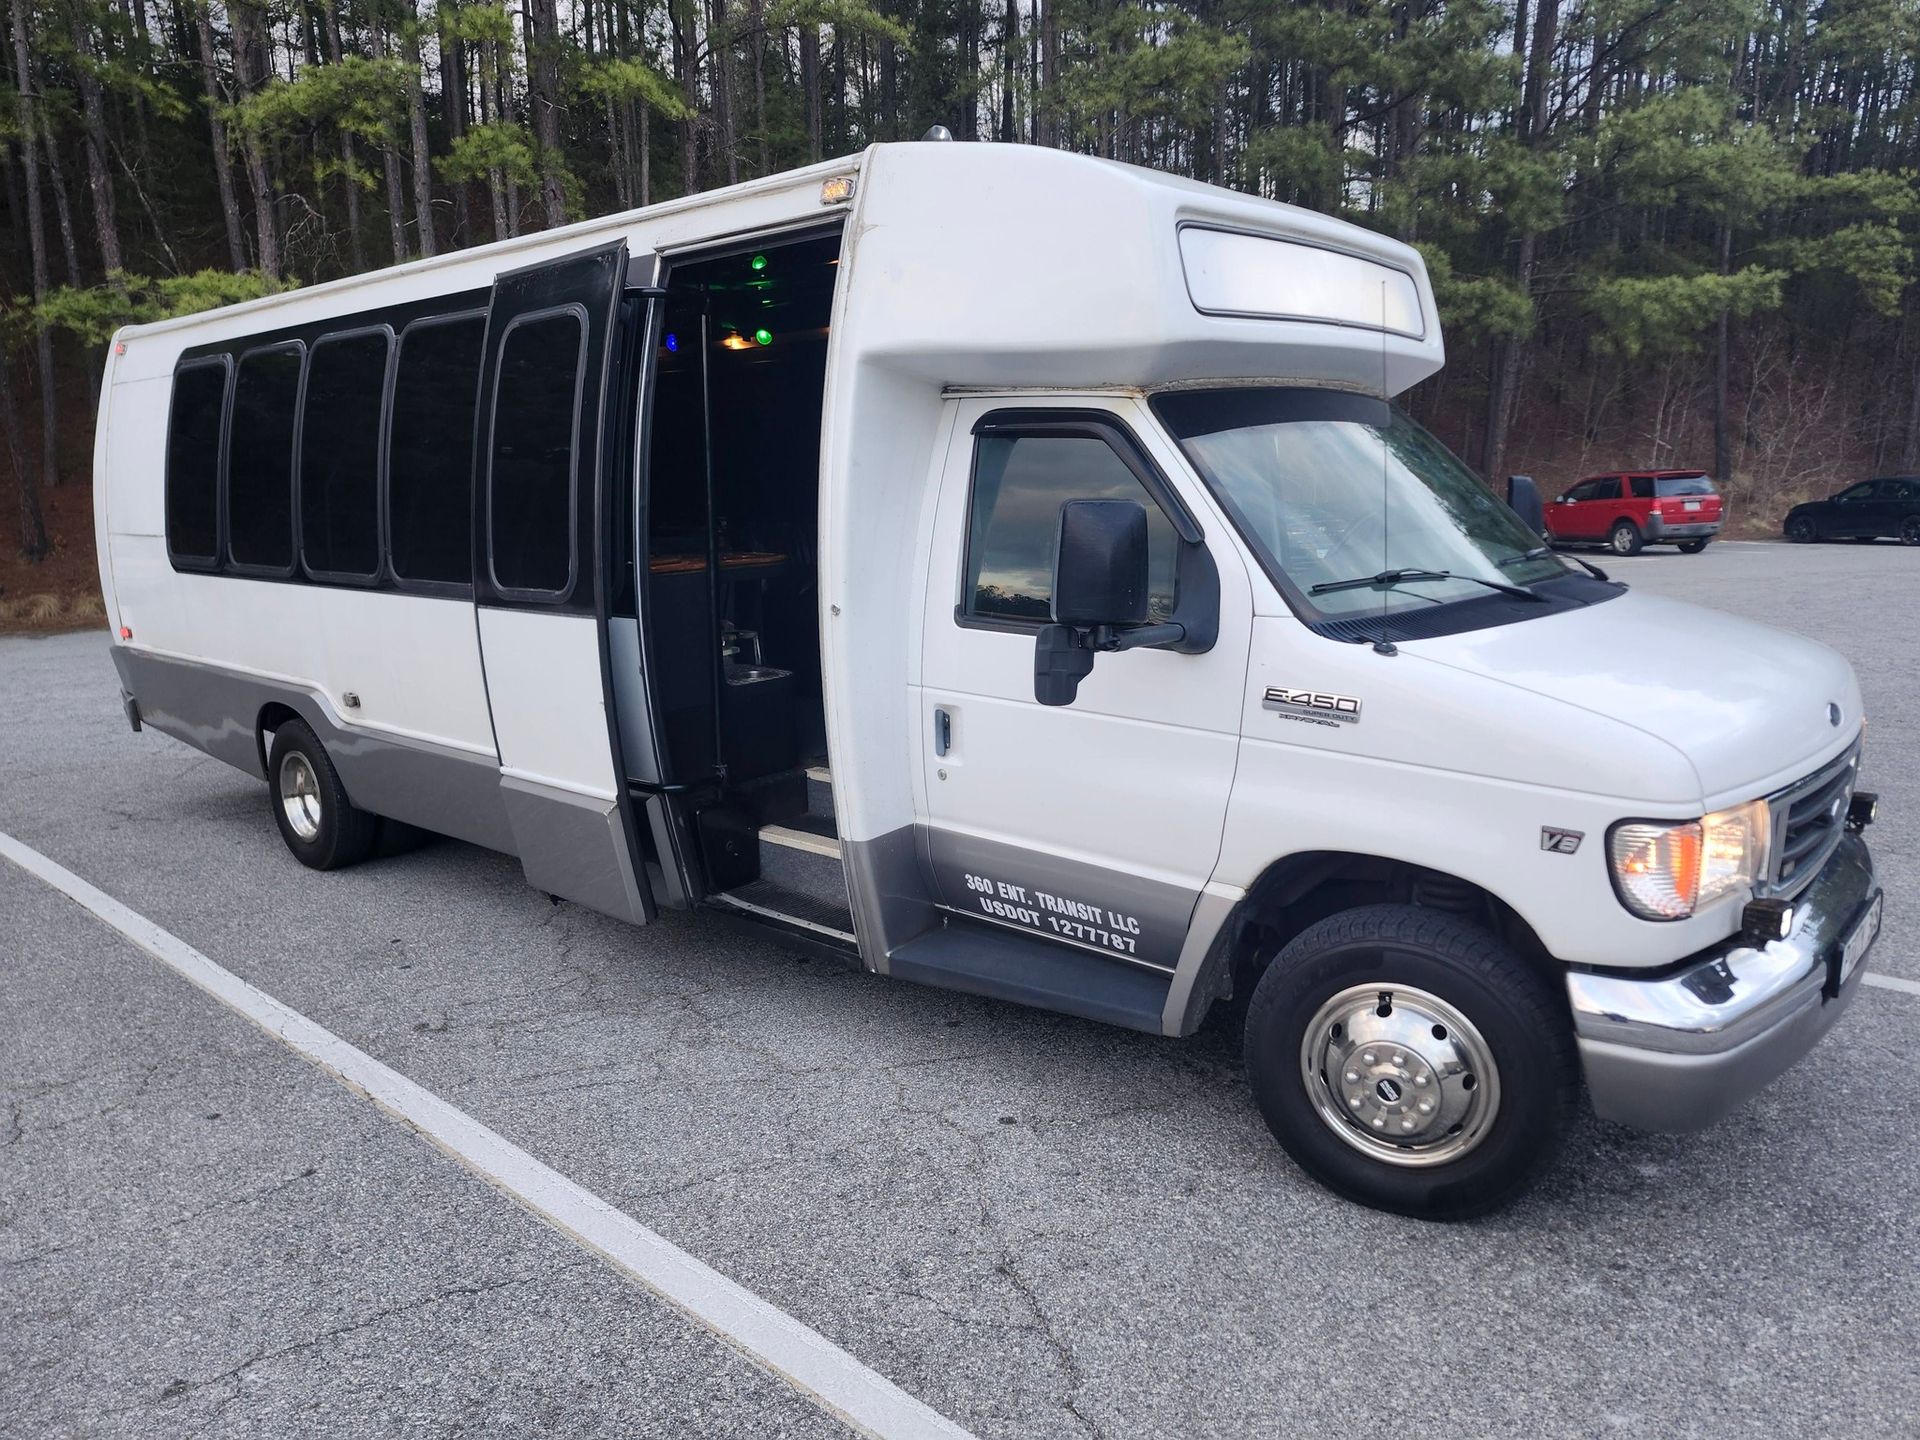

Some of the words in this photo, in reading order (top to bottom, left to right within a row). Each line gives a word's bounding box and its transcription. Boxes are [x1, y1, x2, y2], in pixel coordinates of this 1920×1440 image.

[1302, 709, 1330, 718] SUPER
[1332, 713, 1357, 721] DUTY
[1542, 831, 1580, 852] V8
[965, 873, 994, 895] 360
[997, 881, 1033, 905] ENT.
[1035, 891, 1102, 925] TRANSIT
[1108, 911, 1140, 935] LLC
[979, 897, 1041, 926] USDOT
[1048, 916, 1136, 953] 1277787
